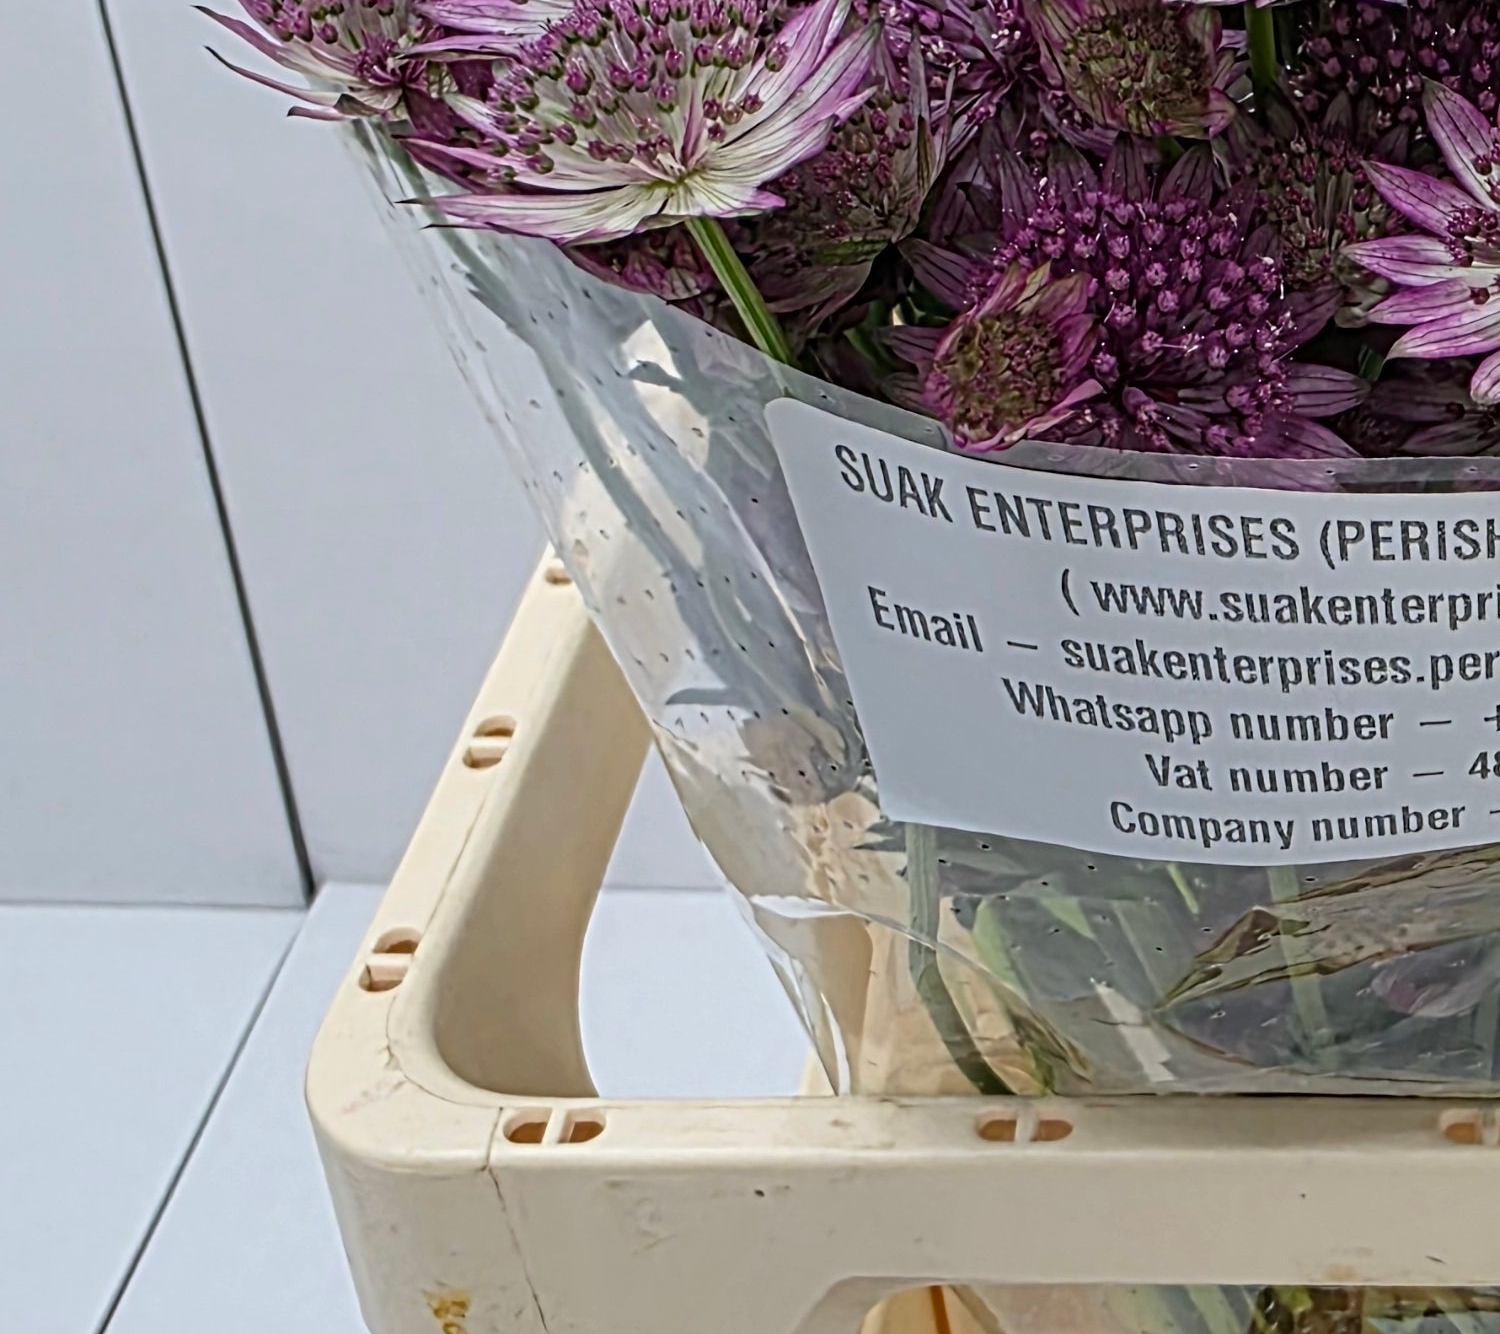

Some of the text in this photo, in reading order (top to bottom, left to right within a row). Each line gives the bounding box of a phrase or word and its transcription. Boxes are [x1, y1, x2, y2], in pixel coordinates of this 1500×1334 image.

[834, 443, 953, 523] SUAK
[965, 483, 1300, 561] ENTERPRISES
[867, 584, 983, 653] Email
[1060, 567, 1080, 617] (
[1001, 676, 1212, 746] Whatsapp
[1229, 708, 1394, 742] number
[1144, 754, 1210, 791] Vat
[1229, 761, 1388, 794] number
[1109, 800, 1295, 851] Company
[1311, 803, 1466, 843] number
